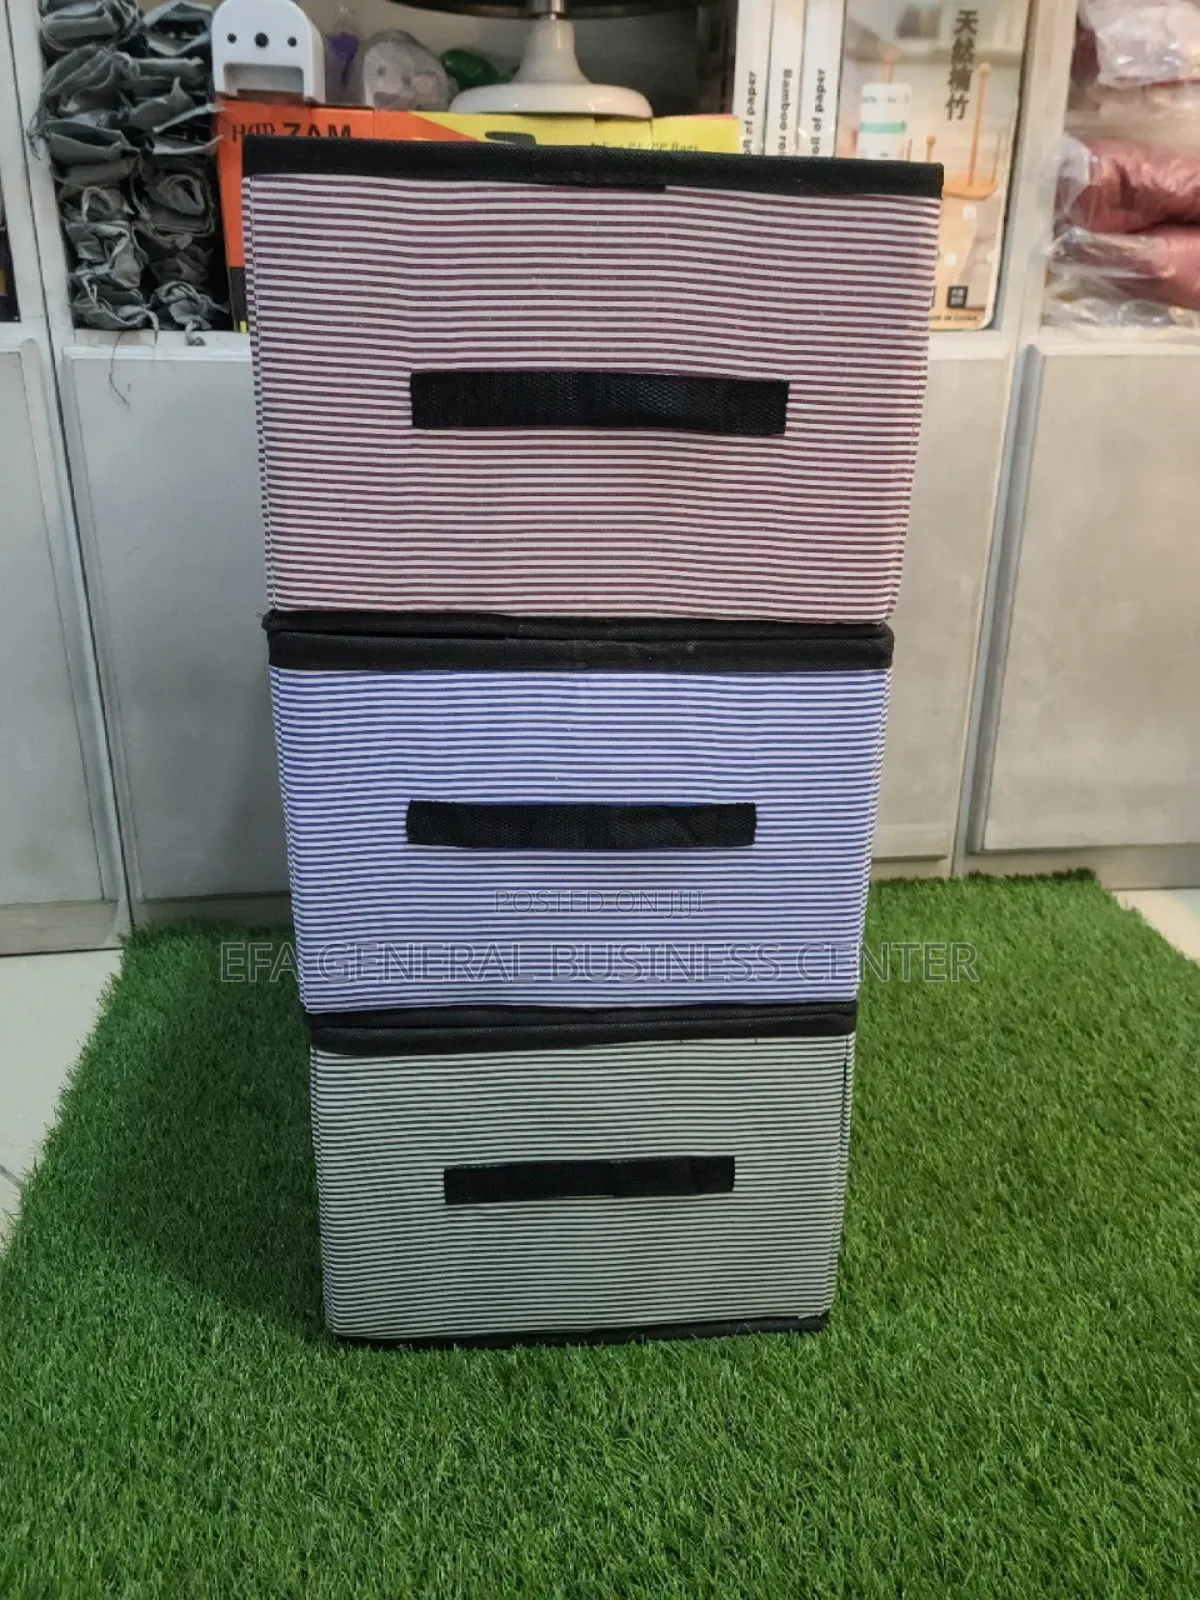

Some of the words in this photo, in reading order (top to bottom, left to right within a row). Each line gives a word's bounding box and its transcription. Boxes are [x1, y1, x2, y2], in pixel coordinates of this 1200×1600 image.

[746, 71, 757, 116] paper
[779, 68, 793, 131] Bamboo
[814, 69, 827, 113] paper
[811, 117, 822, 132] of
